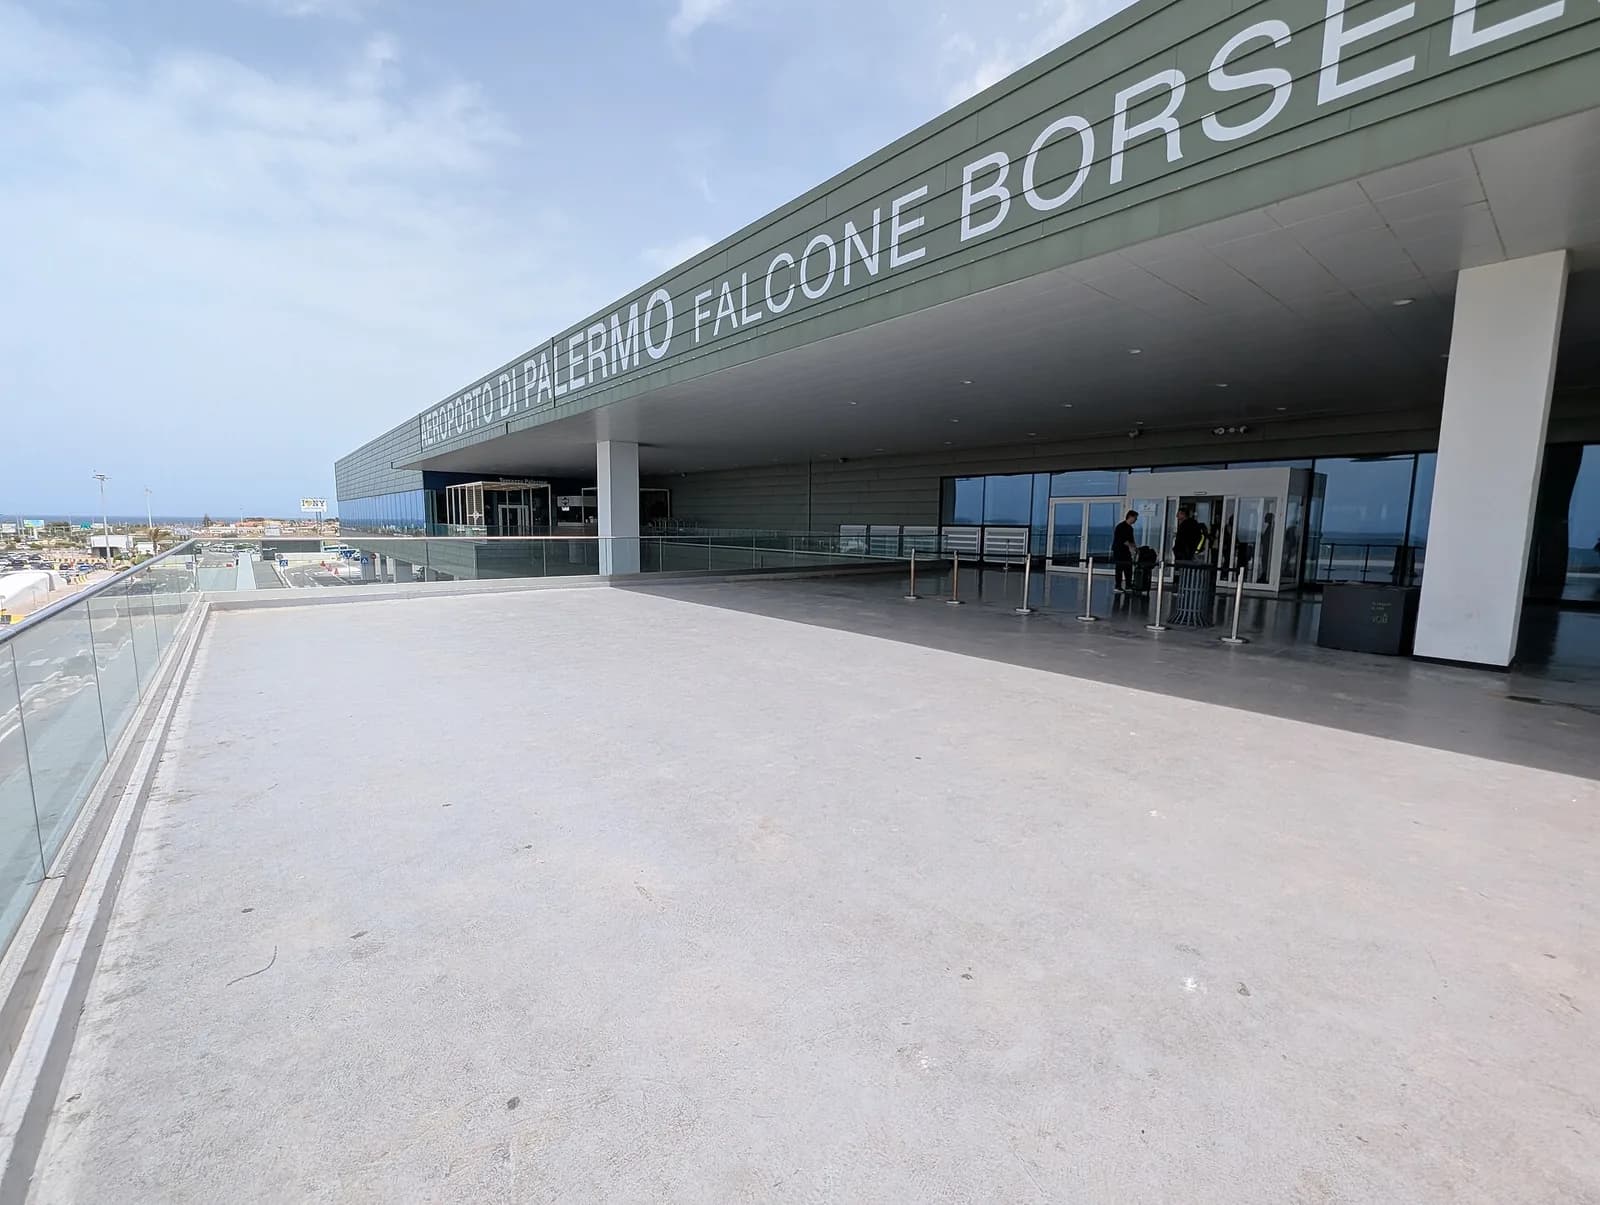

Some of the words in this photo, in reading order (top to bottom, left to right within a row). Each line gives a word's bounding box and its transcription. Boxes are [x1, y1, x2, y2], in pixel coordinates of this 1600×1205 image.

[420, 382, 493, 447] AEROPORTO
[499, 367, 517, 417] DI
[524, 288, 674, 407] PALERMO
[695, 185, 928, 343] FALCONE
